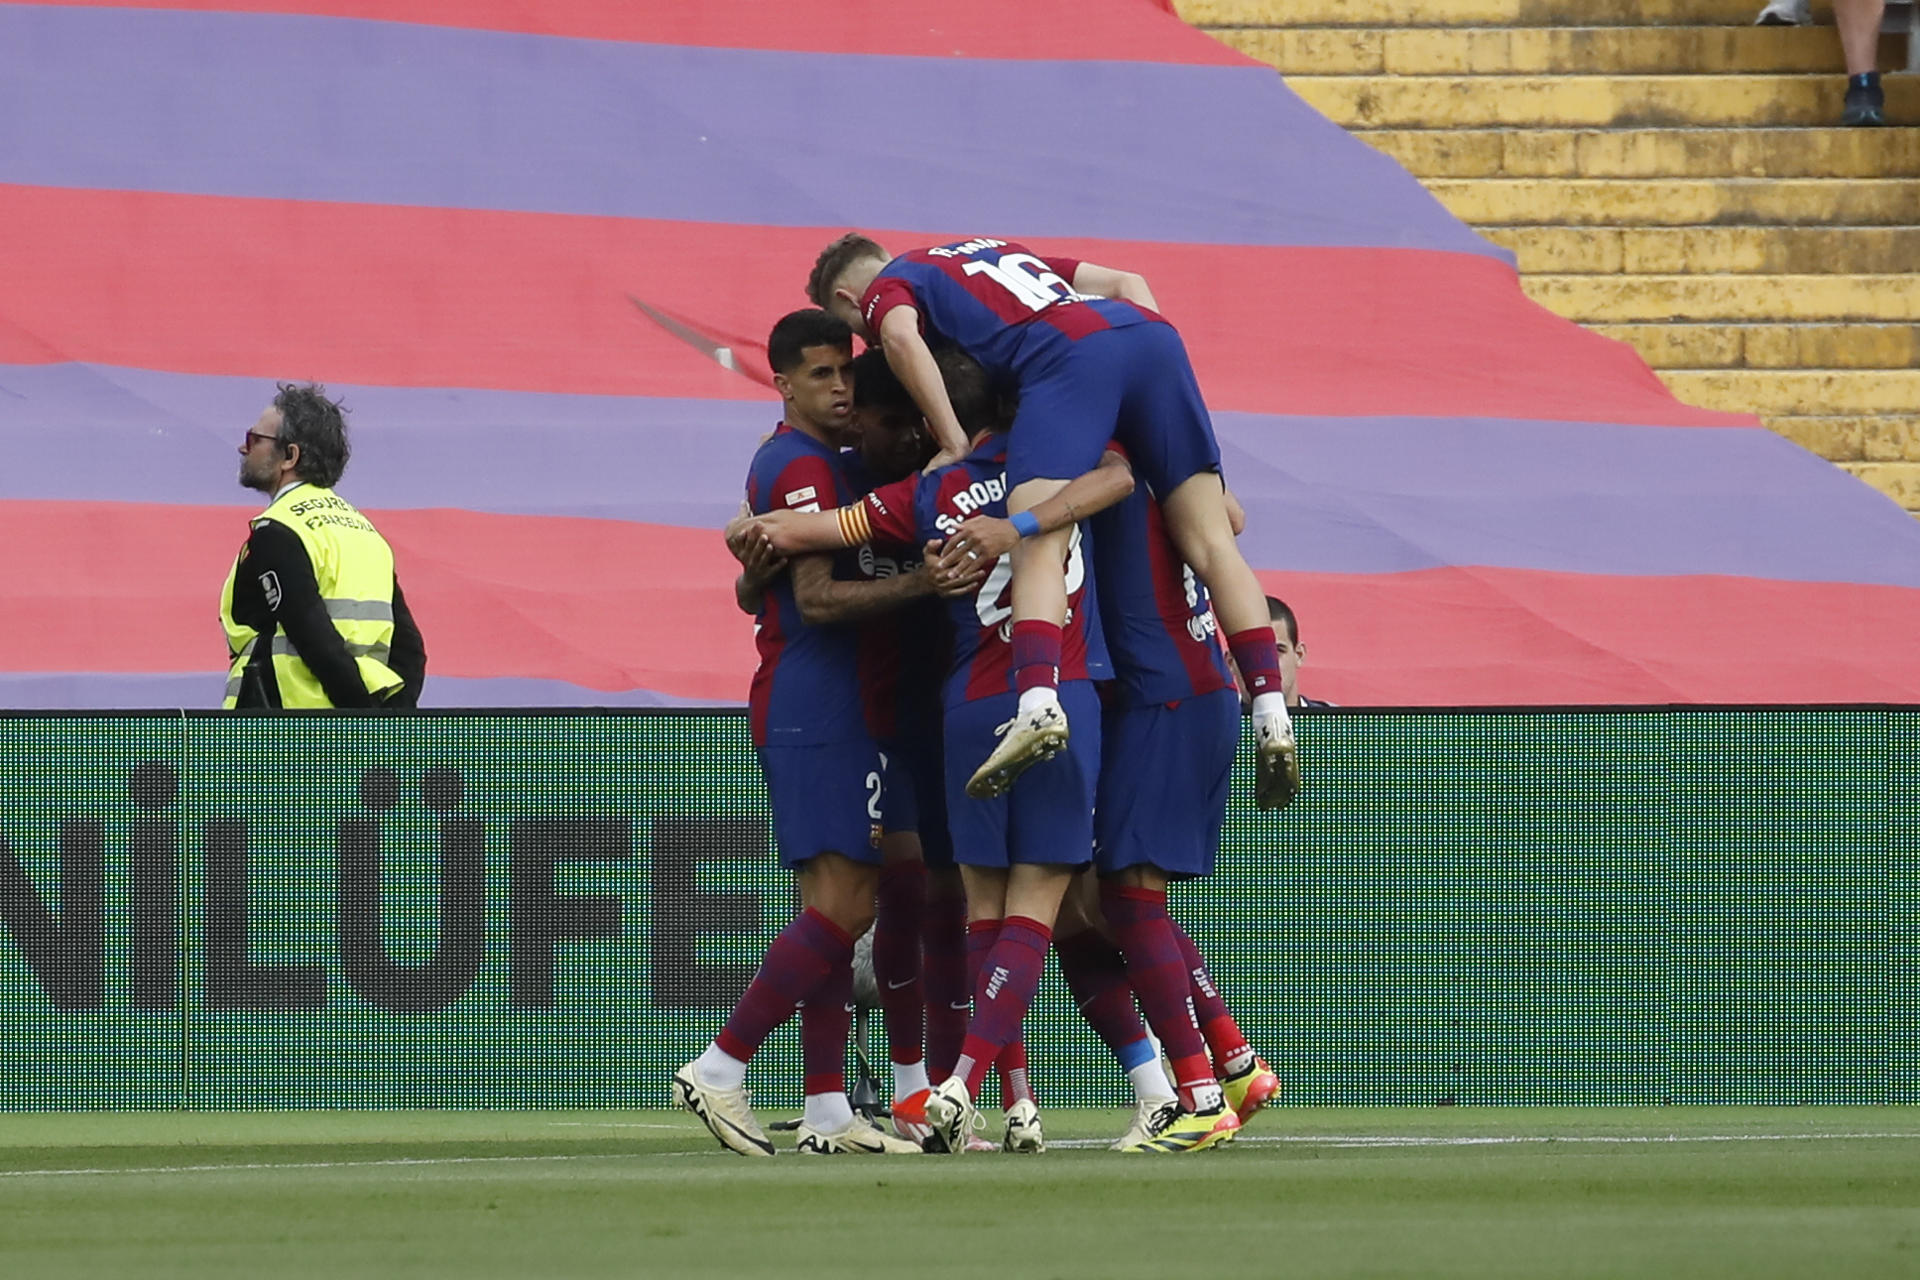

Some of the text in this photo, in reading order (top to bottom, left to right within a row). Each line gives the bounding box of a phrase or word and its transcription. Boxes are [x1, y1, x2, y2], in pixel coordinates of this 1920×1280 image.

[961, 252, 1077, 312] 16
[289, 496, 354, 517] SEGURE
[305, 514, 375, 534] FC BARCELONA
[0, 761, 773, 1012] NİLÜFE
[984, 966, 1010, 1000] BARÇA
